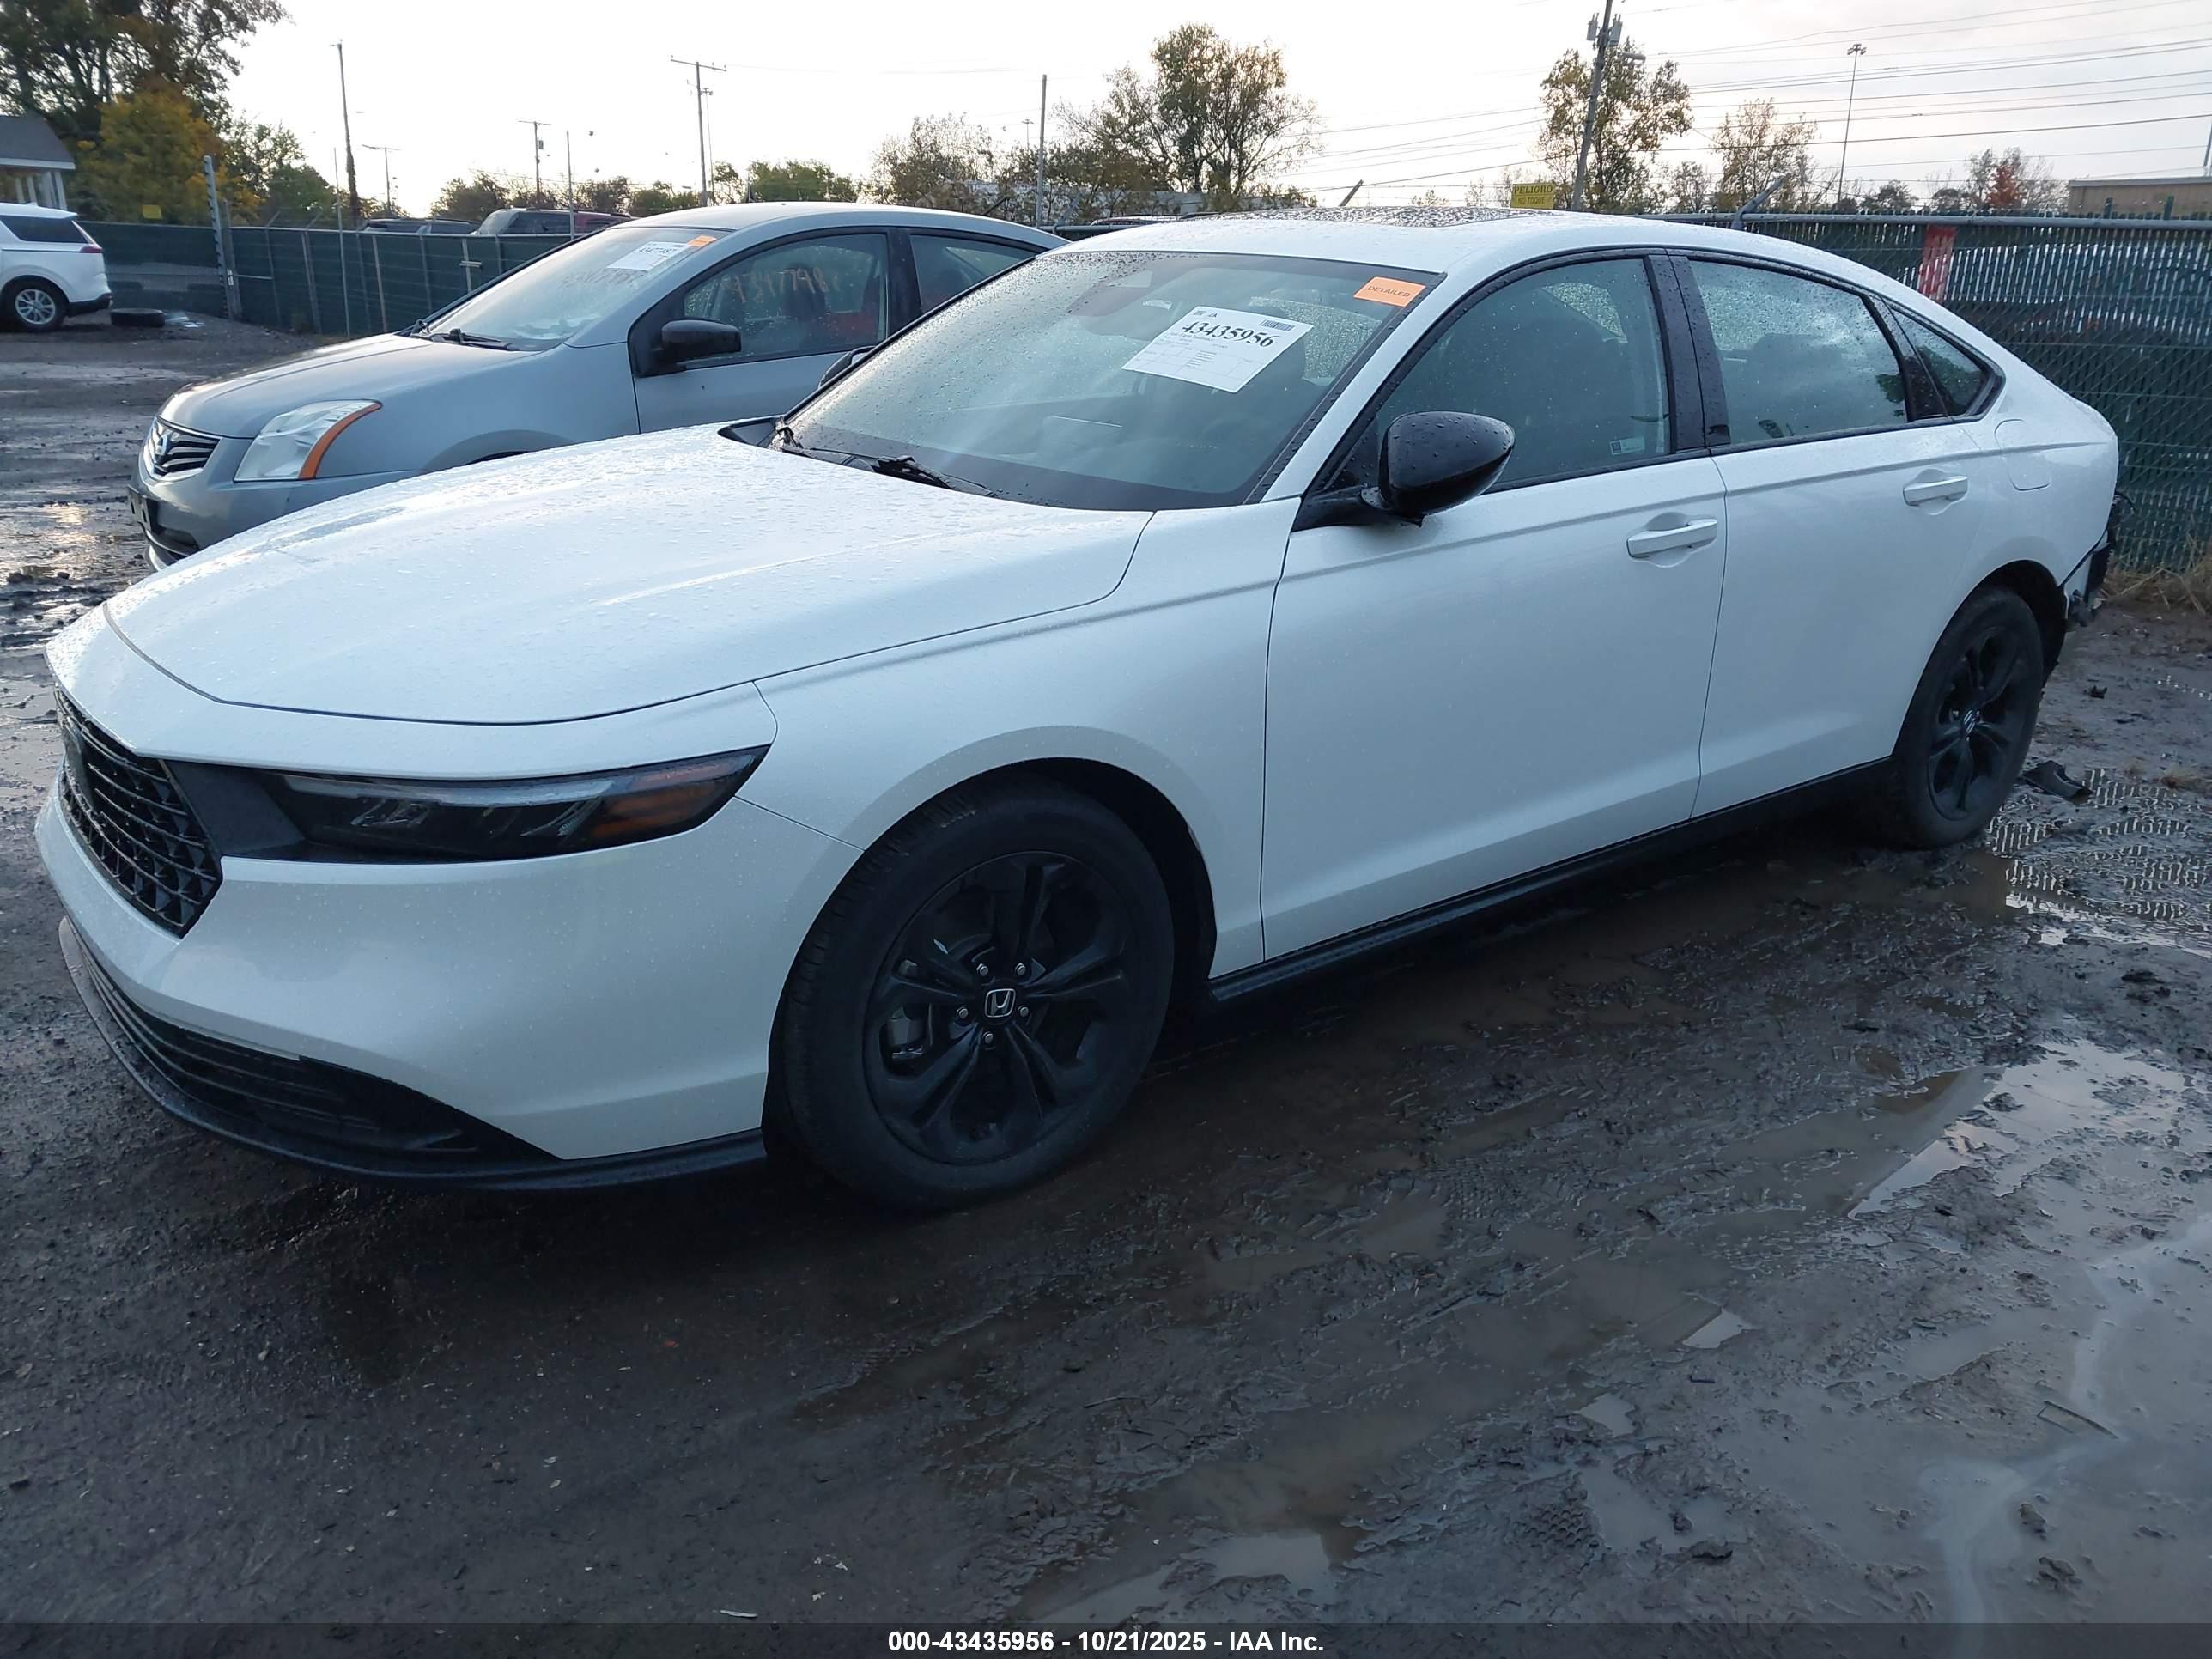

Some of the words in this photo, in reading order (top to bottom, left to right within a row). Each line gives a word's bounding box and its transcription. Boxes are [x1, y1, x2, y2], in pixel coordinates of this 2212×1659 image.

[1513, 185, 1553, 194] PELIGRO
[1367, 285, 1411, 297] DETAILED
[1182, 321, 1280, 348] 43435956
